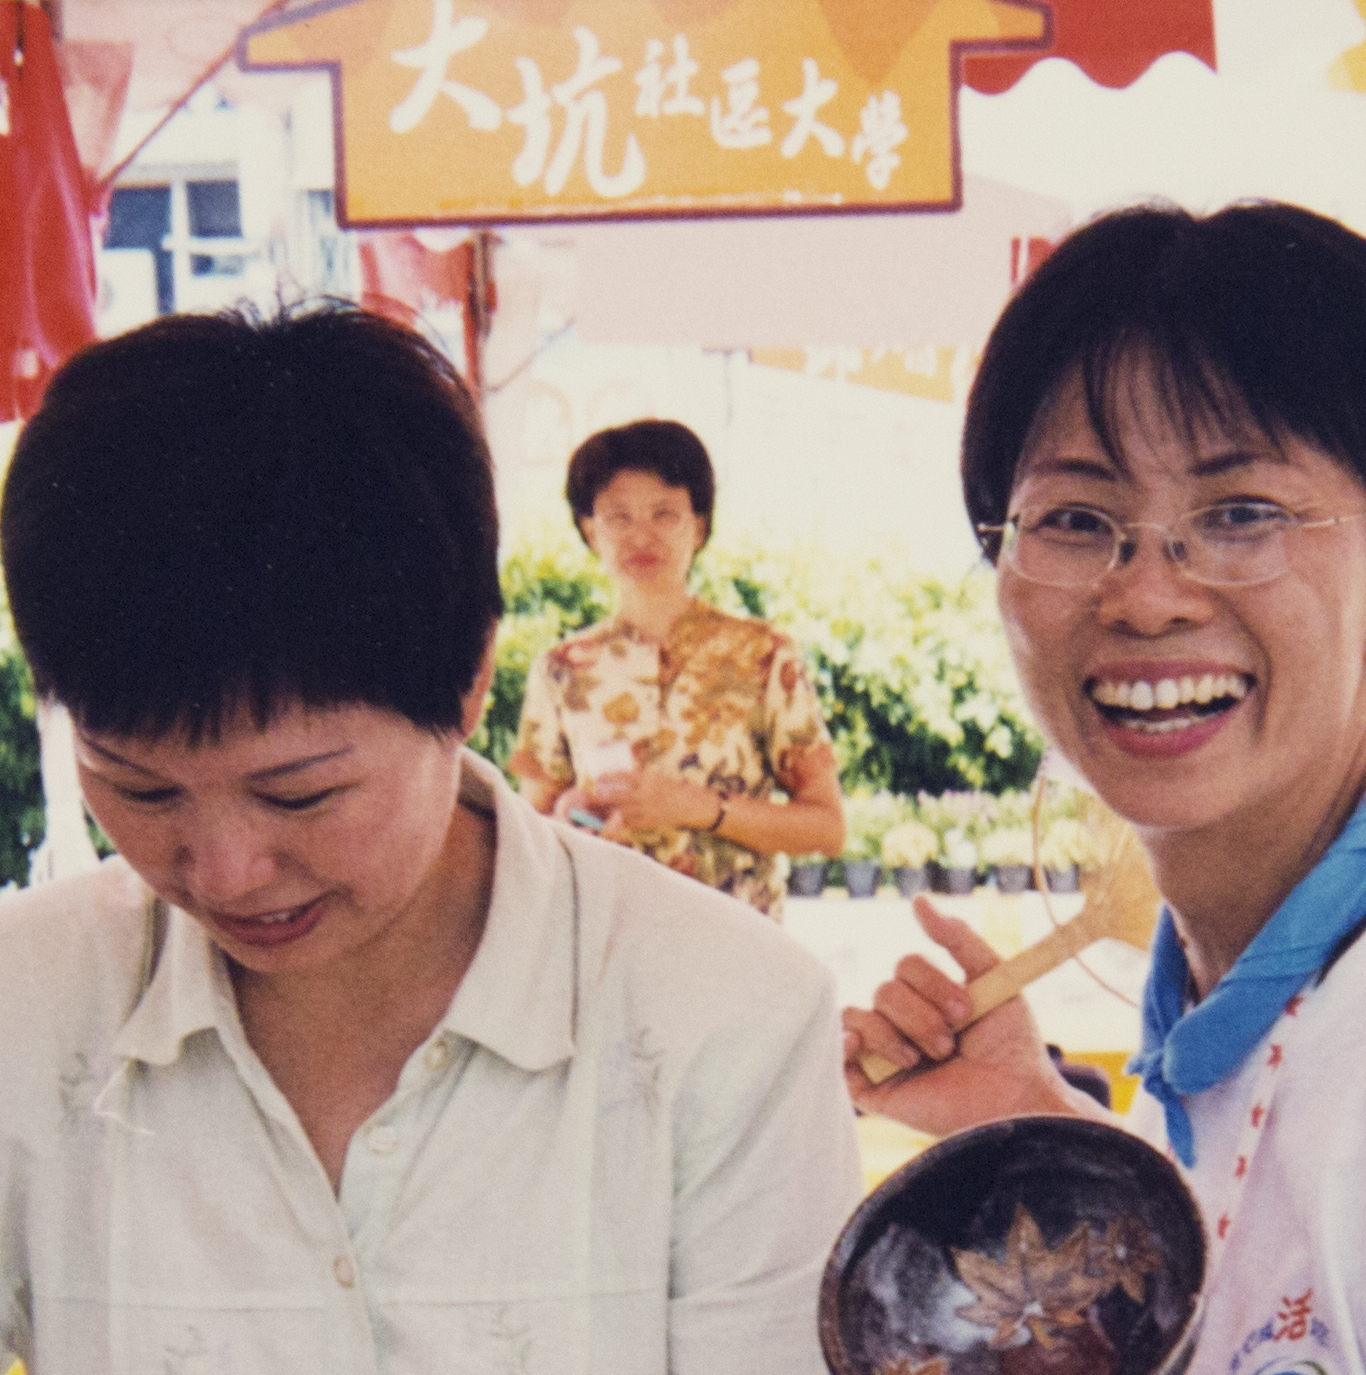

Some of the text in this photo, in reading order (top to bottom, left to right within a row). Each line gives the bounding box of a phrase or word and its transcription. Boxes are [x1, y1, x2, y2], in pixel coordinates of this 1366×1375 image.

[389, 0, 909, 198] 大坑社區大學
